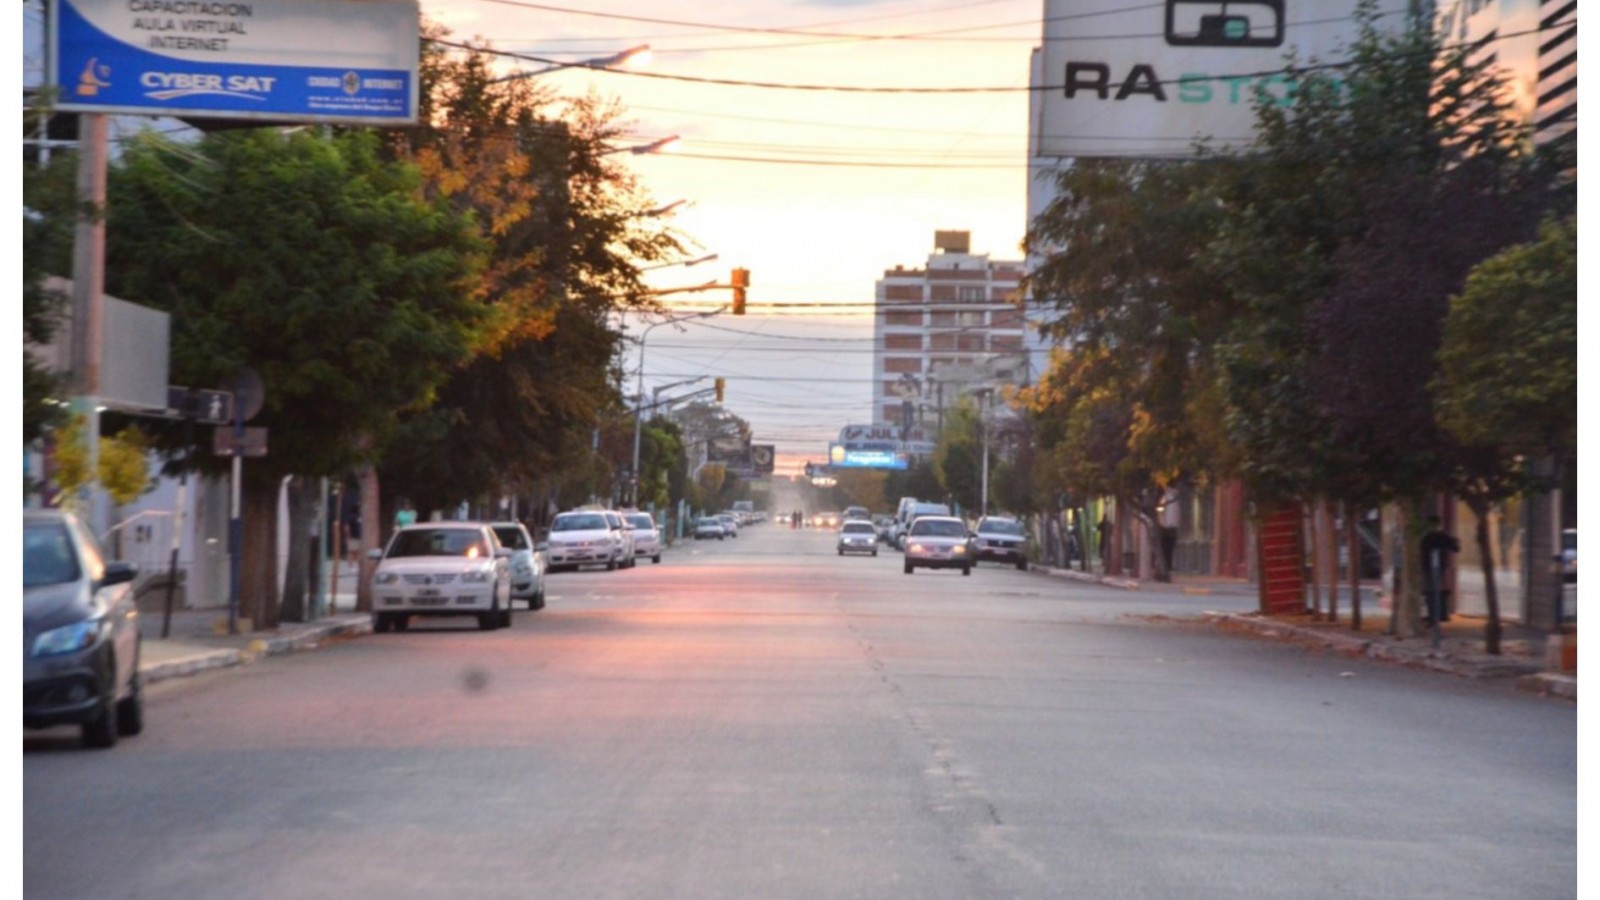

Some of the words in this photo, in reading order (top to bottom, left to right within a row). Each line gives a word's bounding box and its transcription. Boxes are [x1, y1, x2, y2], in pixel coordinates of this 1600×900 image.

[127, 0, 252, 16] CAPACITACION
[133, 18, 175, 31] AULA
[181, 19, 247, 35] VIRTUAL
[148, 35, 228, 51] INTERNET
[140, 72, 223, 90] CYBER
[227, 76, 276, 92] SAT
